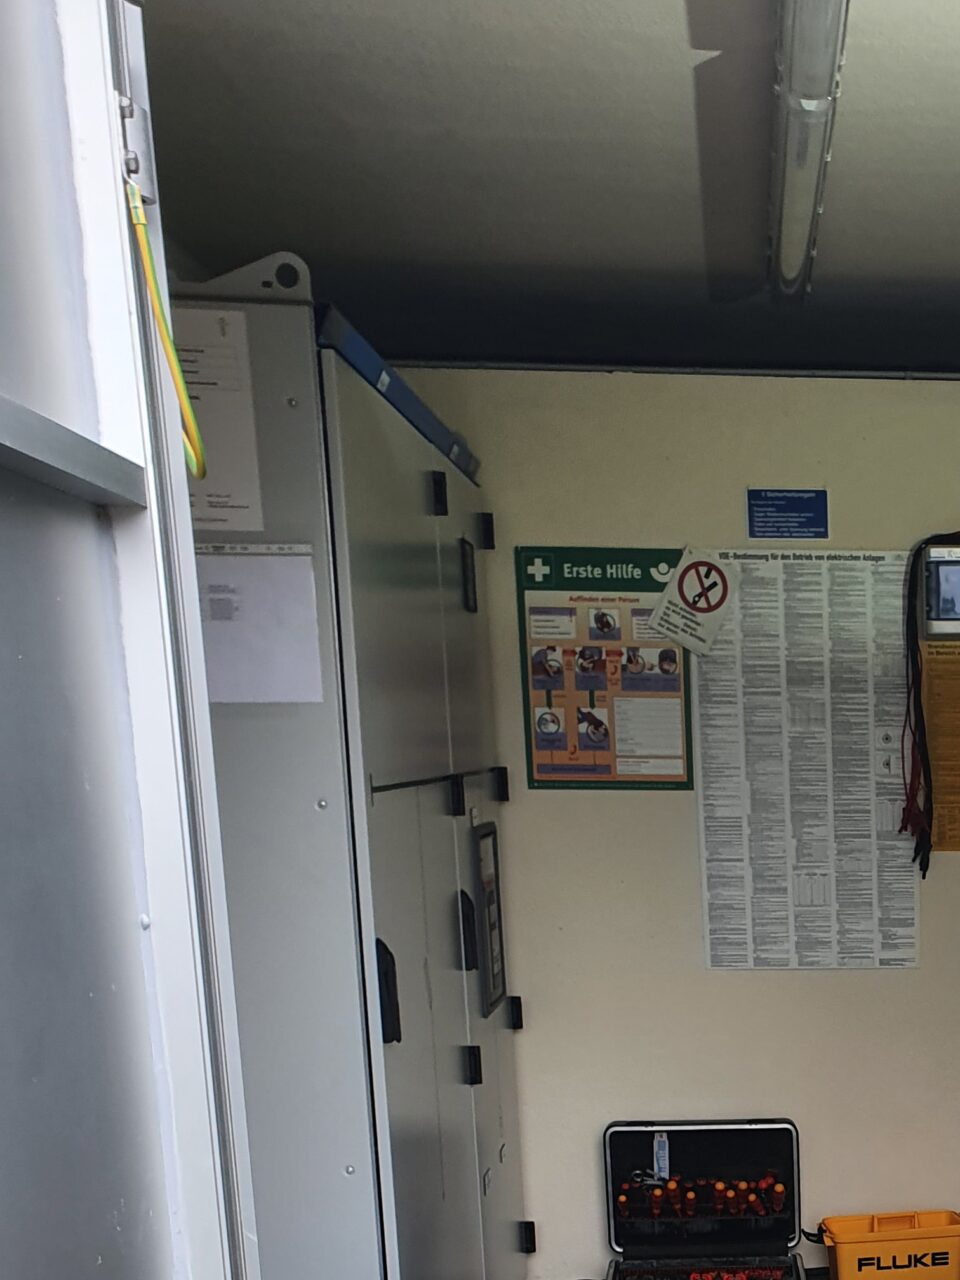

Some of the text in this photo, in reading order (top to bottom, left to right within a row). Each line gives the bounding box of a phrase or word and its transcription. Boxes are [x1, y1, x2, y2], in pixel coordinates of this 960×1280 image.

[563, 563, 642, 580] Erste Hilfe
[857, 1251, 950, 1273] FLUKE
